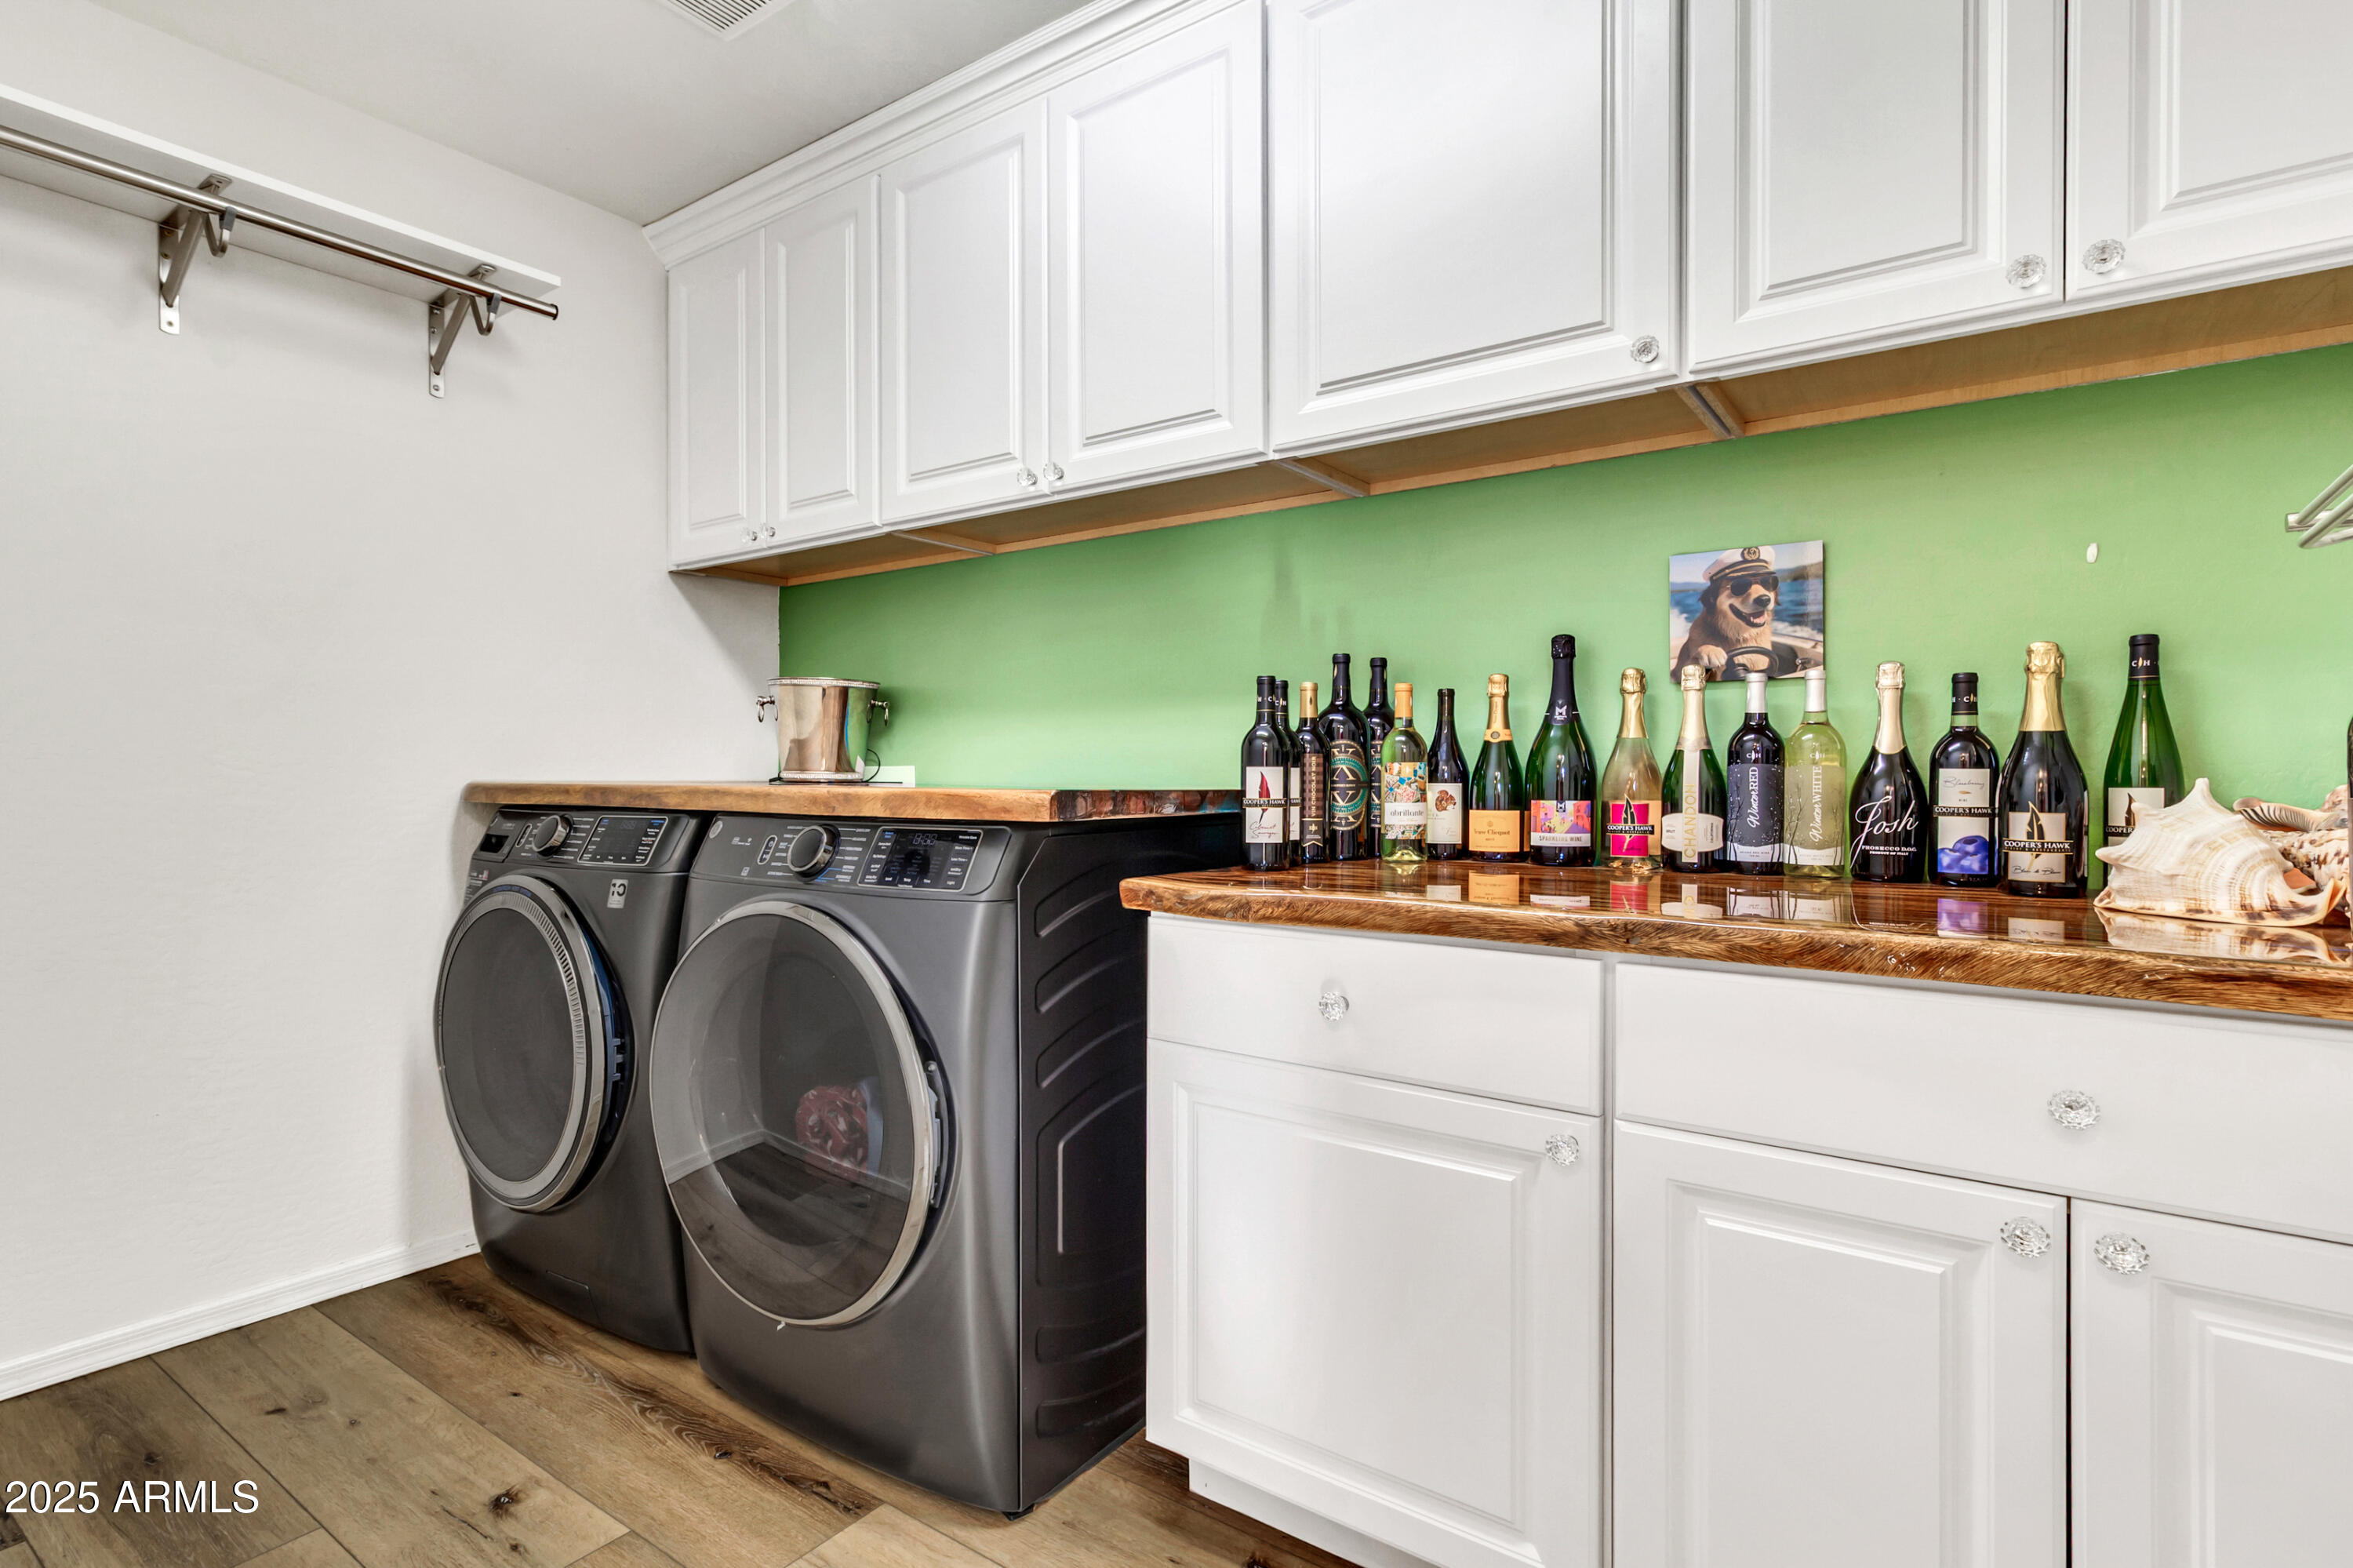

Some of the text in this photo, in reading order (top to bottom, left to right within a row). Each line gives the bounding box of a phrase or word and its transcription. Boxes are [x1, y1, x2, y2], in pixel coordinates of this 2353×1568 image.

[1684, 784, 1697, 858] CHANDON
[1850, 795, 1918, 868] Josh
[2004, 840, 2042, 849] COOPER'S
